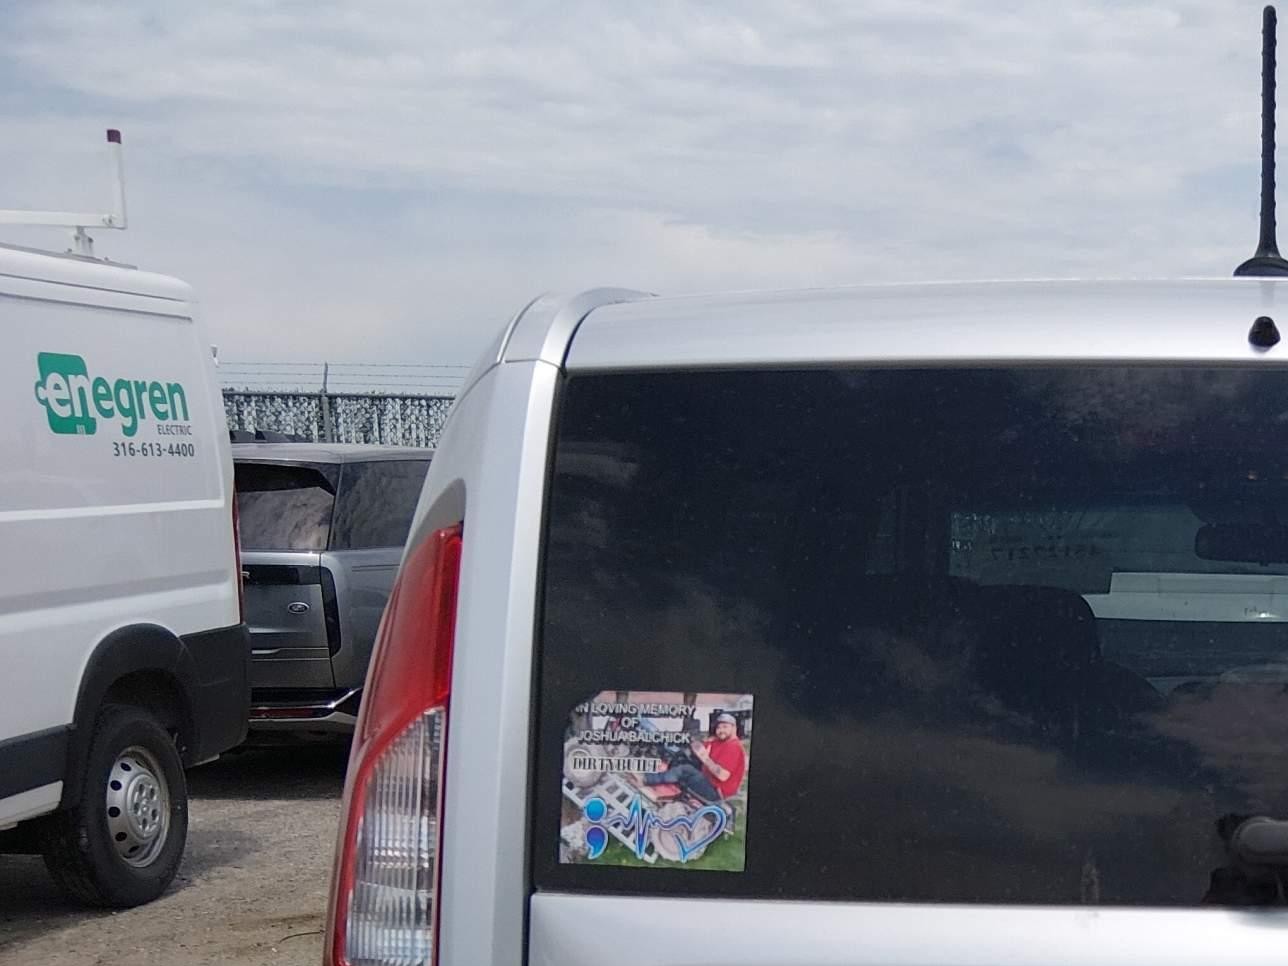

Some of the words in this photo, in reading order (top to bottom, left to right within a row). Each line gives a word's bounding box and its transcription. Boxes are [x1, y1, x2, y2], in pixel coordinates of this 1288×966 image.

[156, 424, 193, 436] ELECTRIC
[112, 441, 195, 457] 316-613-4400
[591, 702, 639, 715] LOVING
[640, 703, 695, 716] MEMORY
[621, 717, 639, 728] OF
[578, 730, 625, 742] JOSHUA
